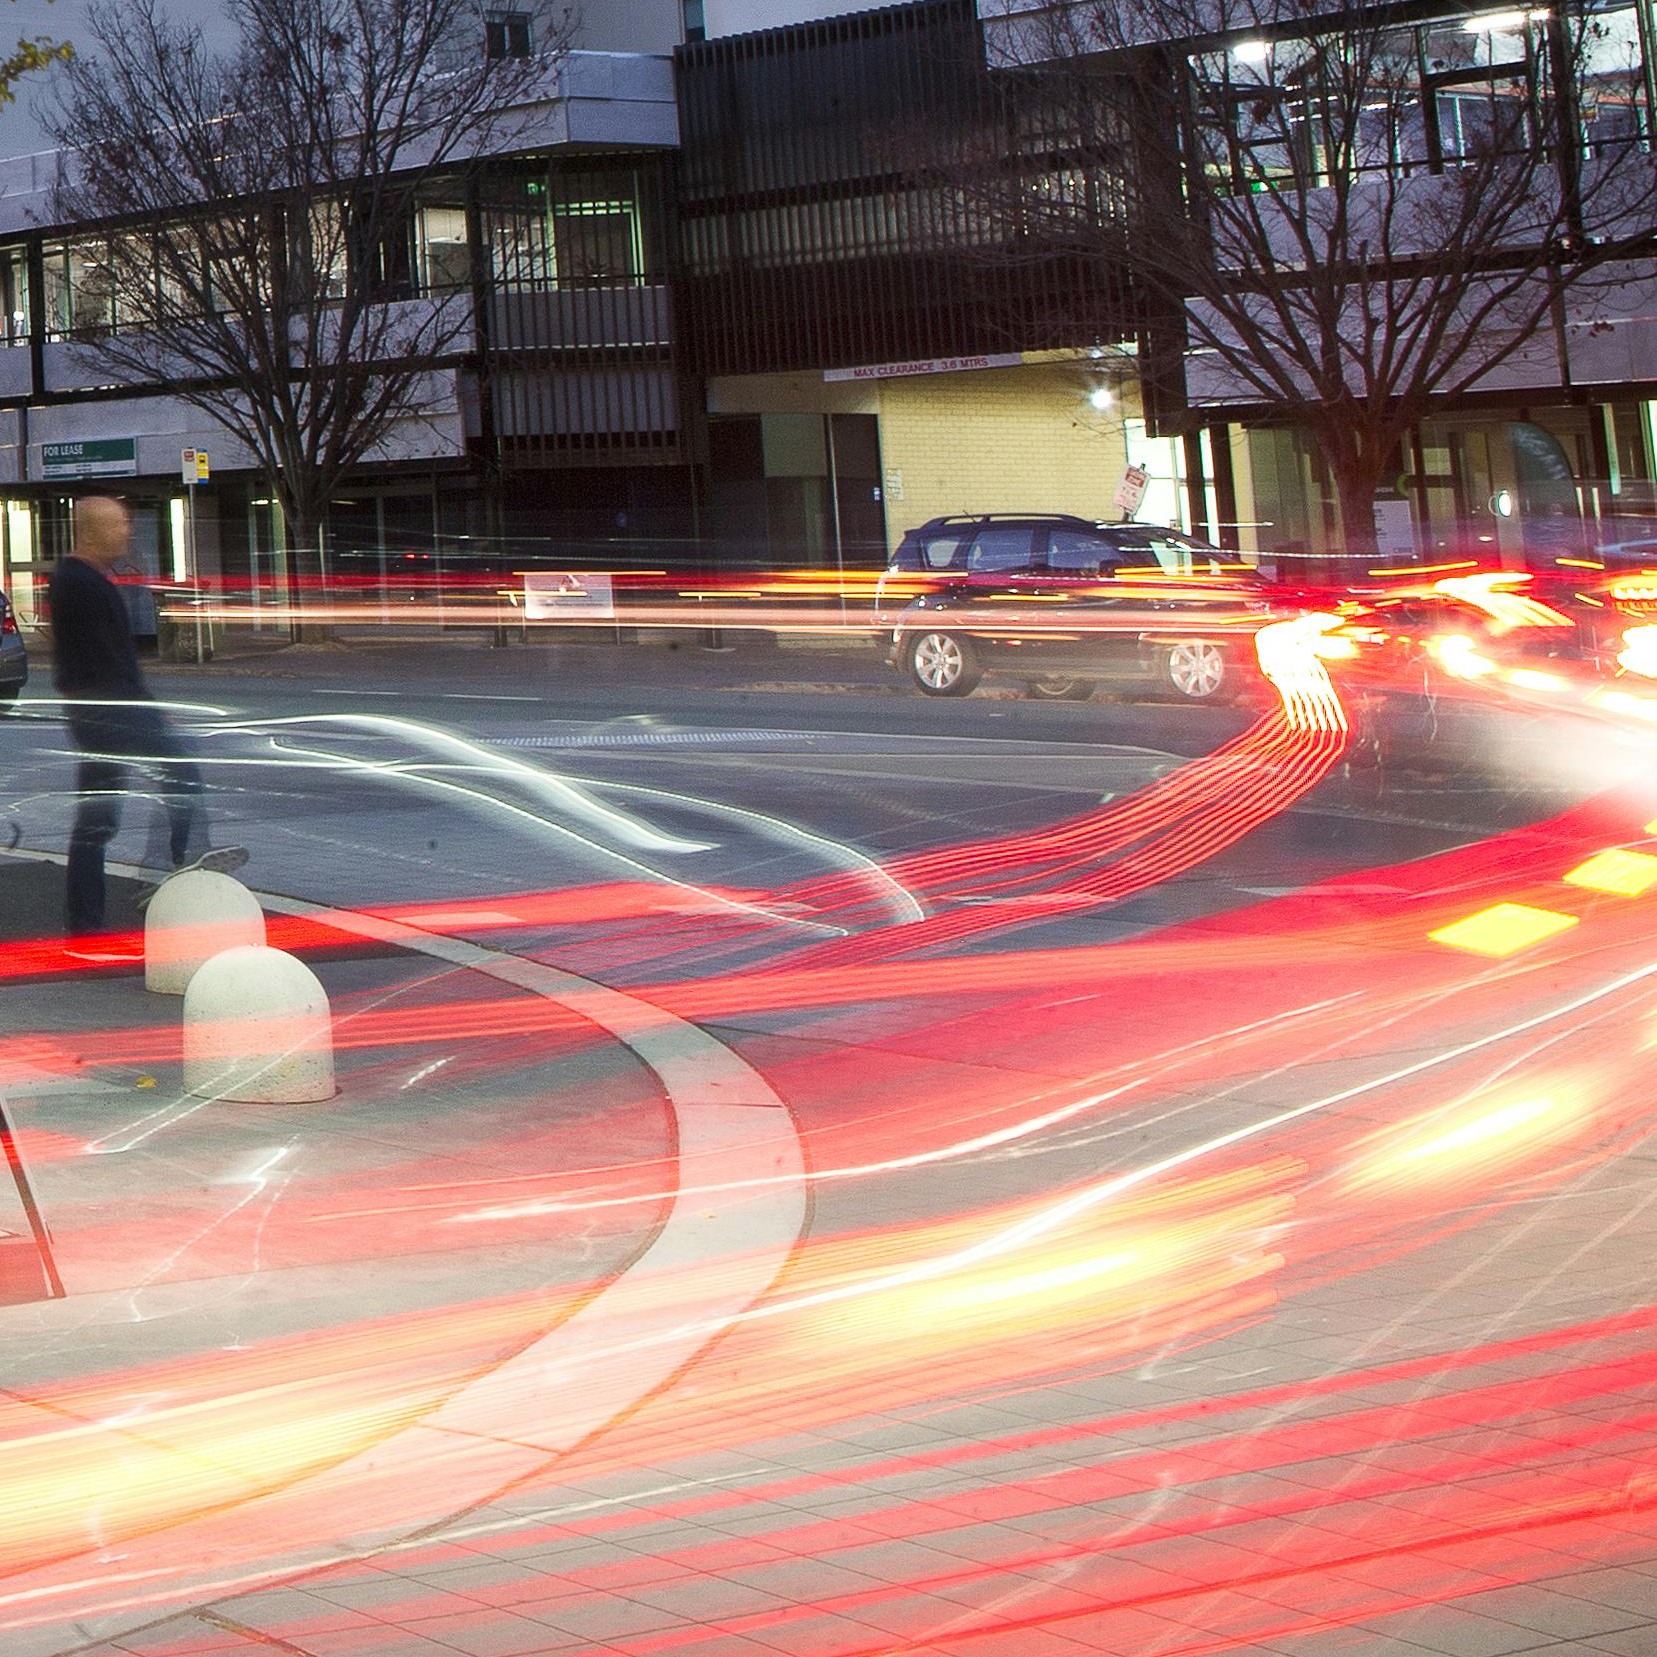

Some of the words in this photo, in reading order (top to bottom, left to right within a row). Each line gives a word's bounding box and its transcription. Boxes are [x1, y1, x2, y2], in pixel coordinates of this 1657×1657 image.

[854, 367, 874, 377] MAX
[878, 362, 935, 376] CLEARANCE
[959, 357, 988, 369] MTRS
[44, 446, 59, 457] FOR
[60, 444, 83, 456] LEASE
